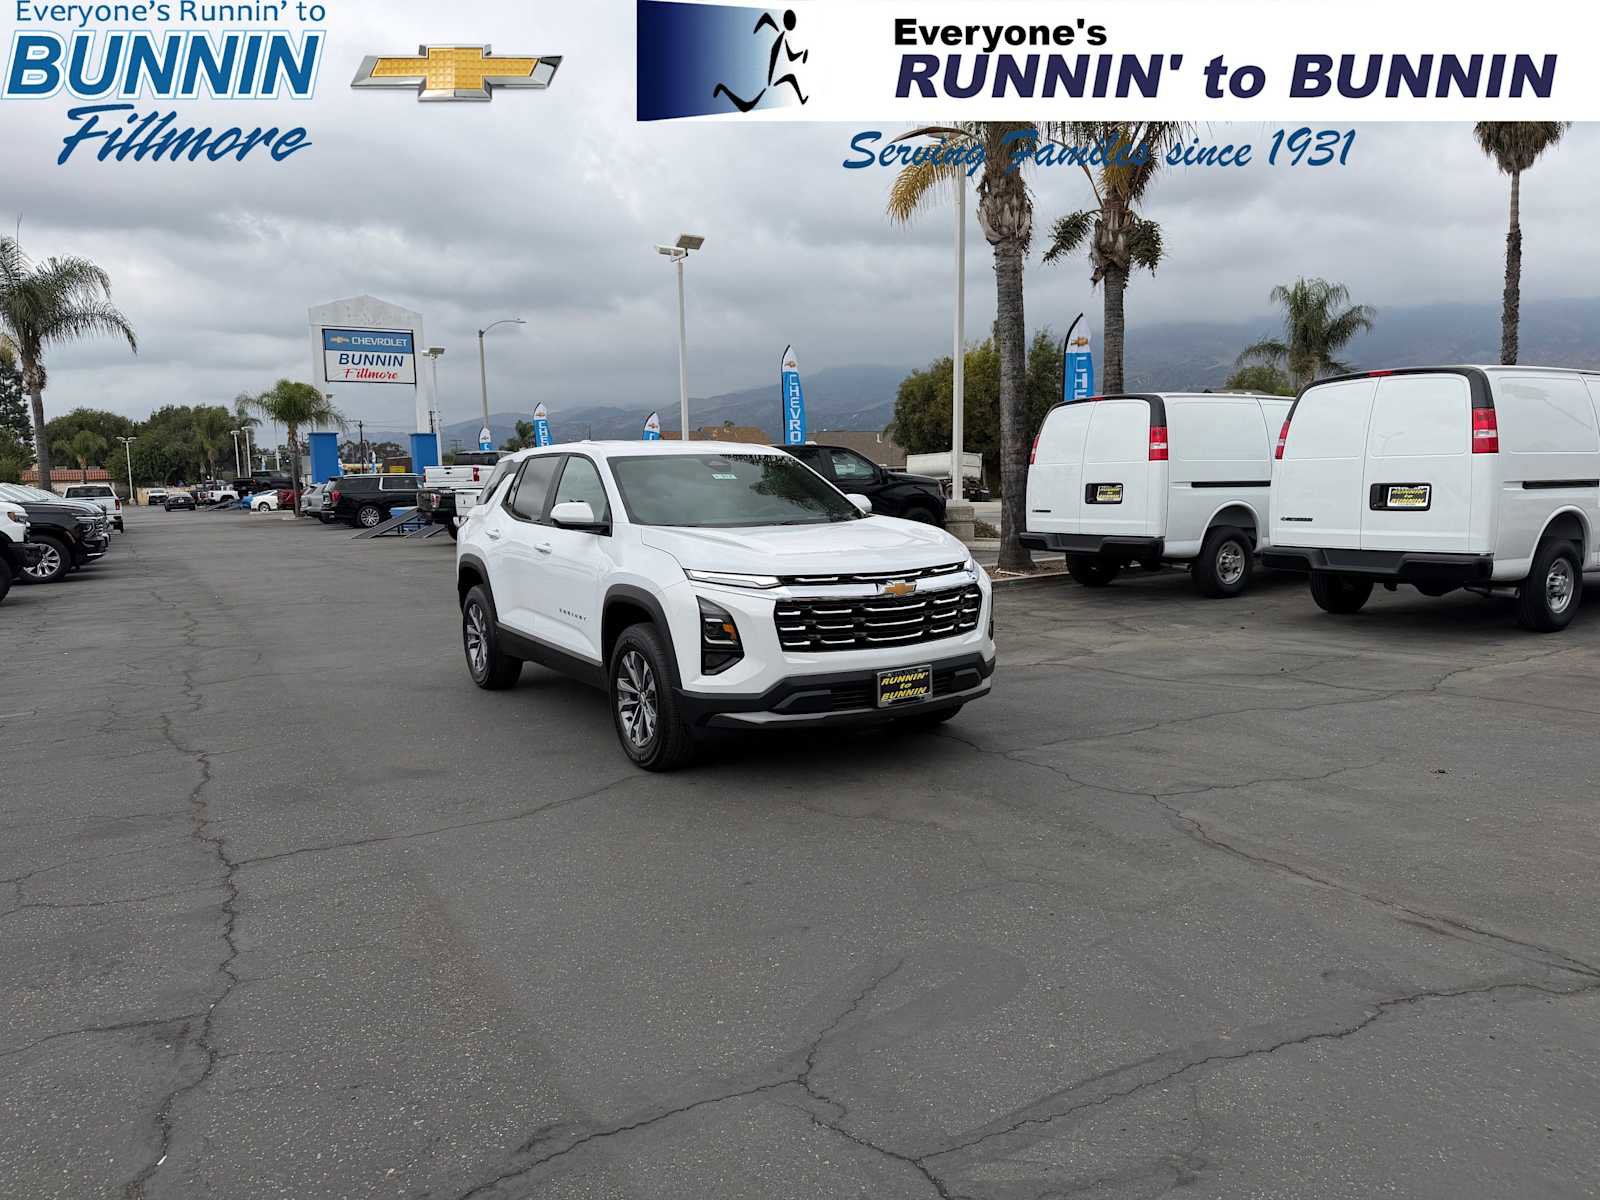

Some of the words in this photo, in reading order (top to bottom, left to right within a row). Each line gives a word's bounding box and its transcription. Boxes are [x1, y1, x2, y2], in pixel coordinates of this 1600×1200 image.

[351, 336, 407, 347] CHEVROLET
[339, 353, 404, 367] BUNNIN
[344, 368, 398, 380] Fillmore
[789, 373, 802, 445] CHEVRO
[881, 686, 928, 701] BUNNIN
